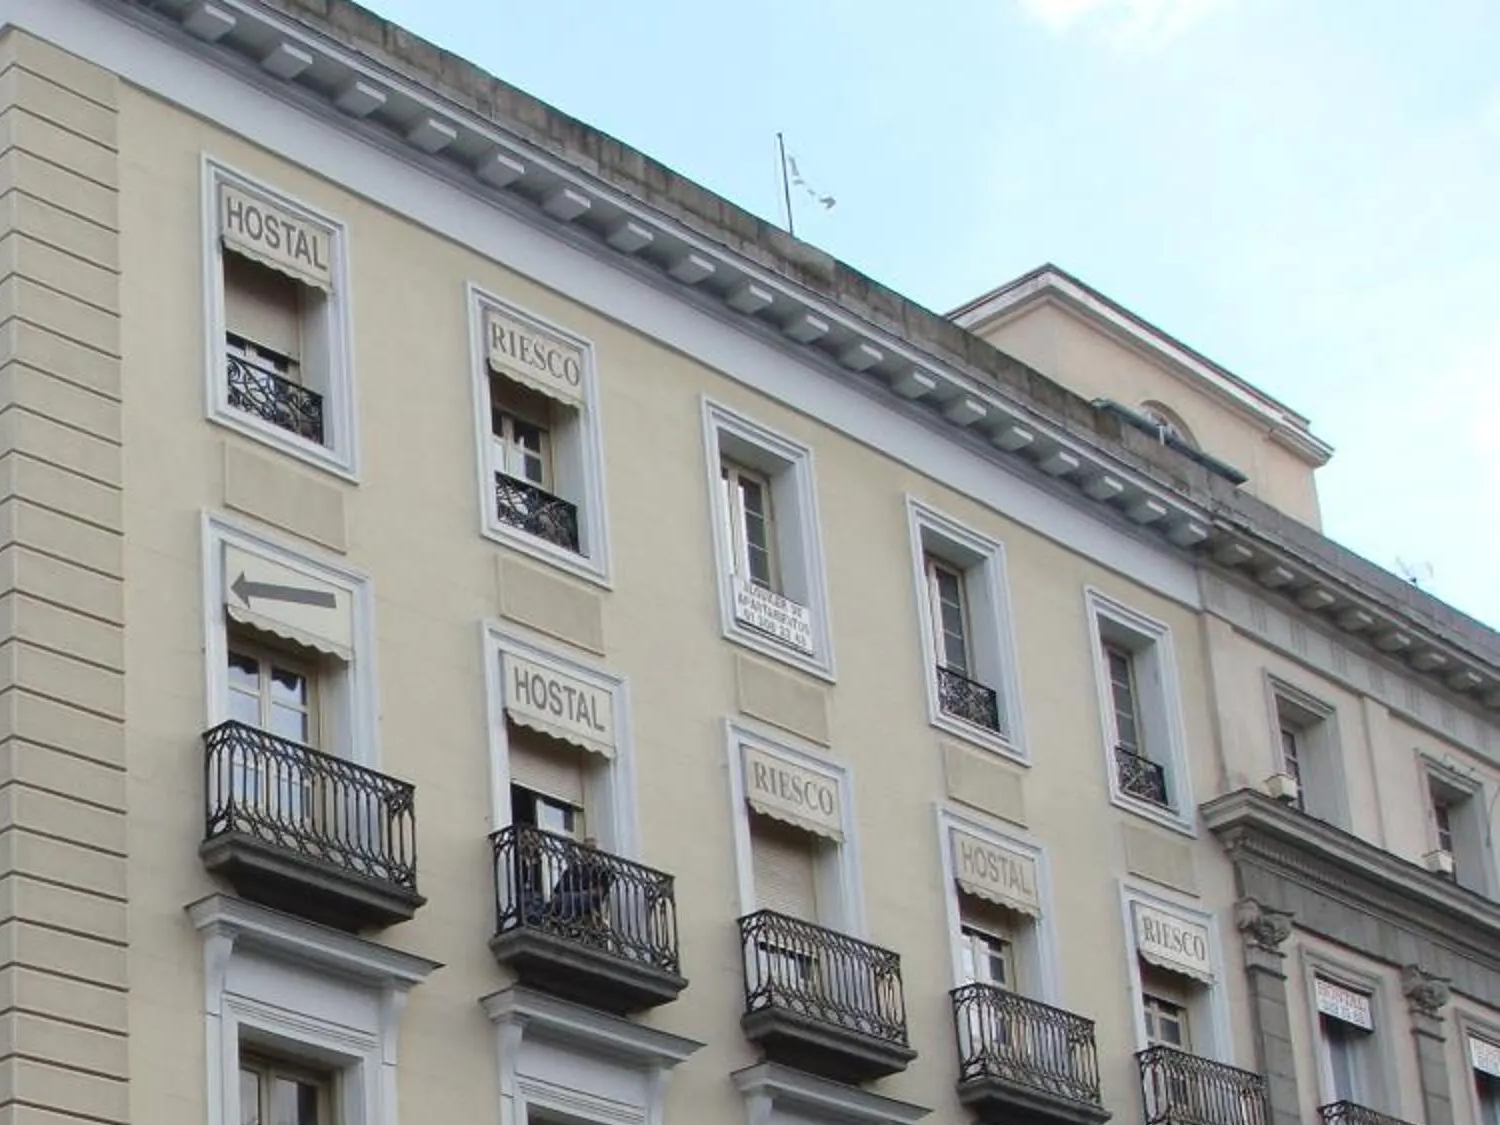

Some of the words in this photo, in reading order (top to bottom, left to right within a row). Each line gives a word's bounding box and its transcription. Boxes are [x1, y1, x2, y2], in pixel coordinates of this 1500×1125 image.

[226, 196, 328, 271] HOSTAL
[491, 322, 580, 388] RIESCO
[514, 667, 606, 733] HOSTAL
[754, 761, 834, 816] RIESCO
[961, 840, 1031, 897] HOSTAL
[1142, 915, 1205, 961] RIESCO
